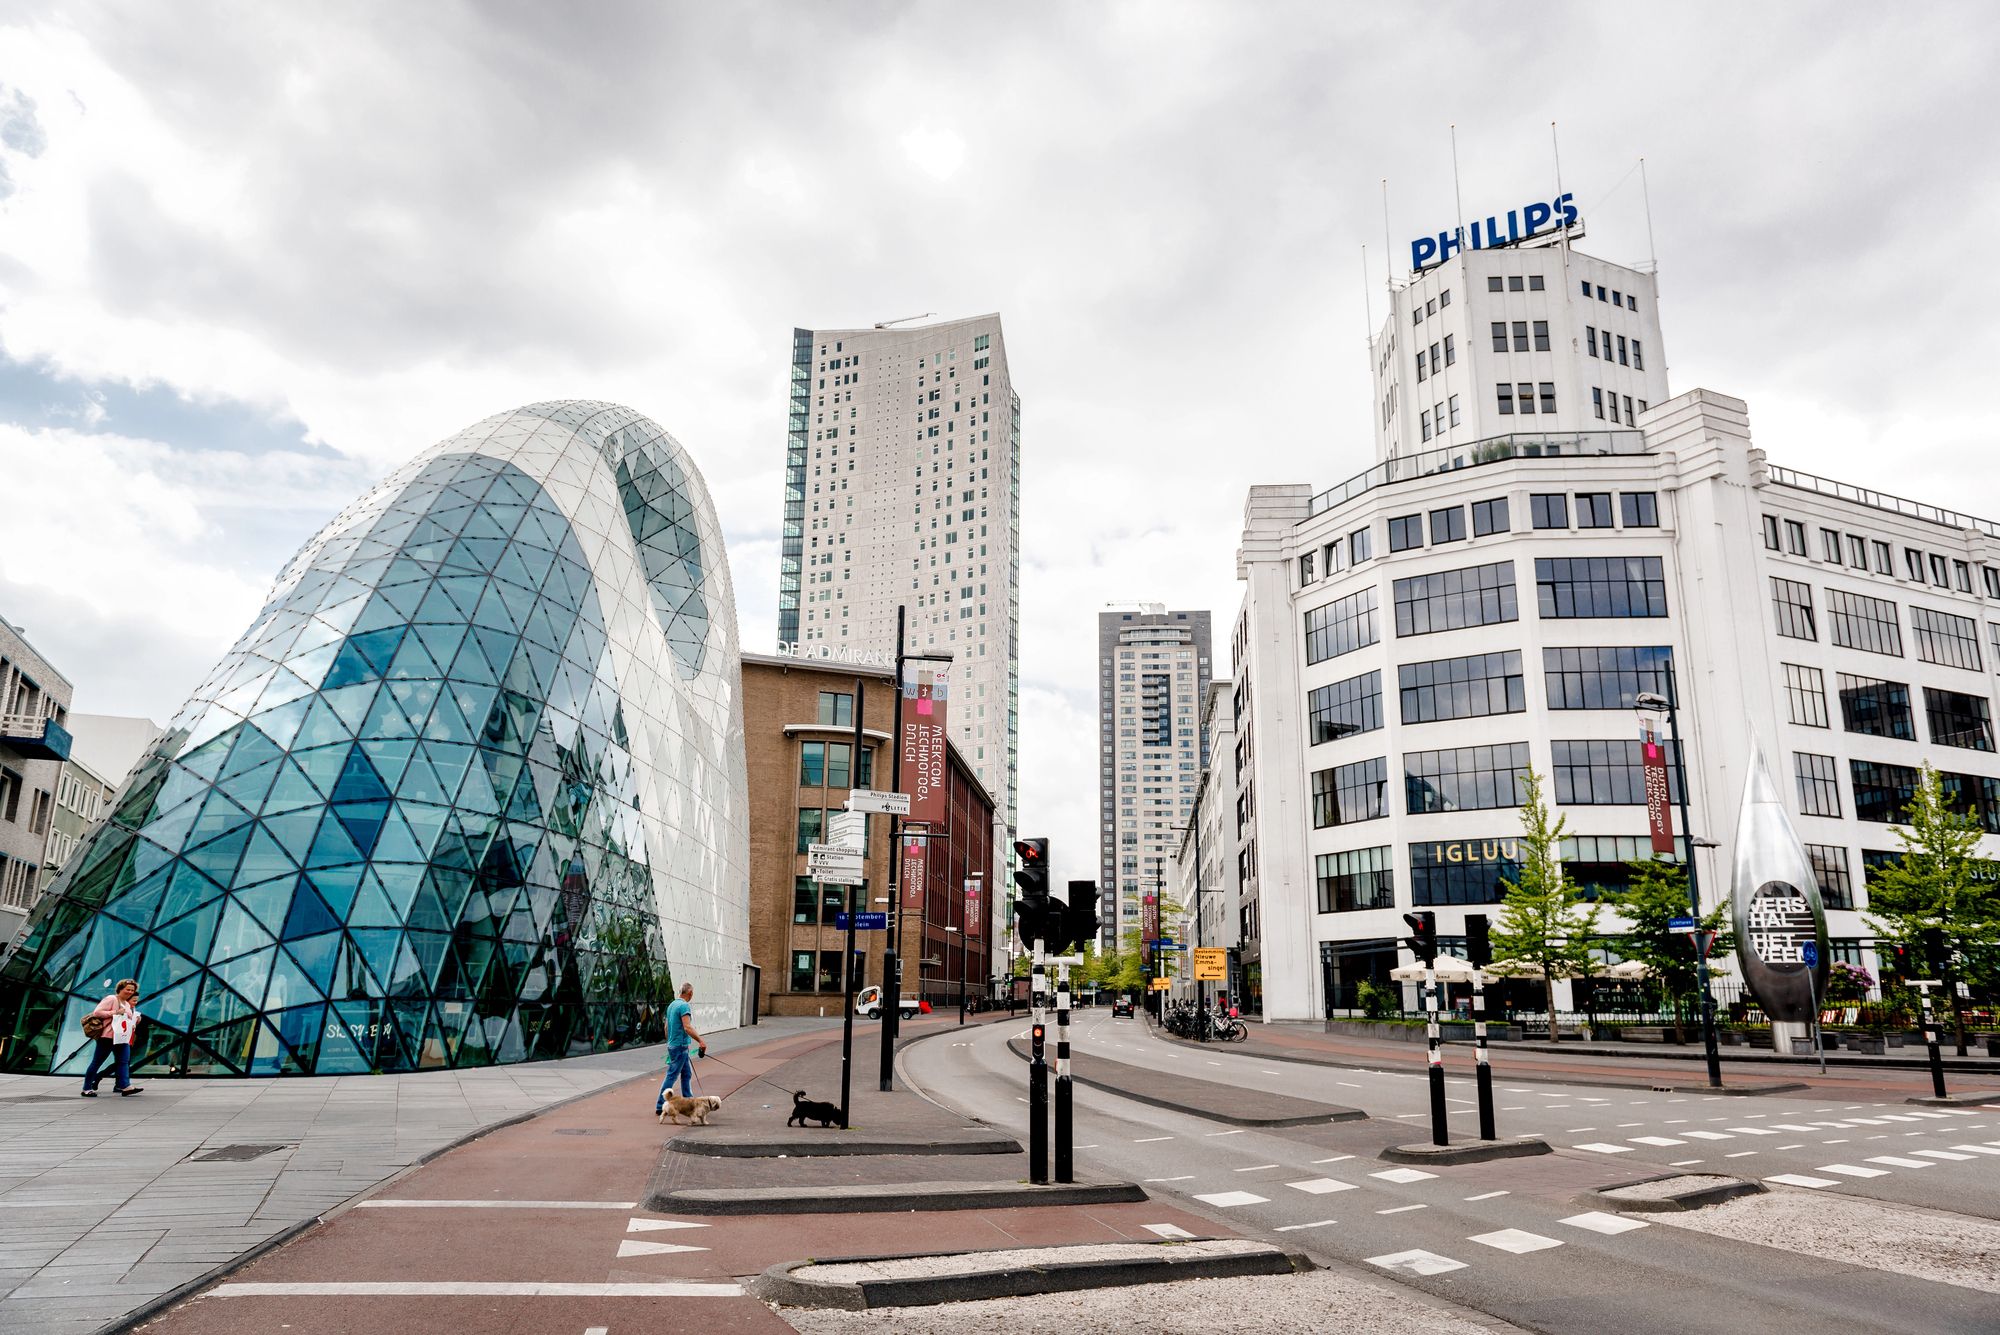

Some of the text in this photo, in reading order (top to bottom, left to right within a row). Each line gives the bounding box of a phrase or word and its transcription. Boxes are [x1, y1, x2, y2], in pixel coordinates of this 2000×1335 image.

[1411, 192, 1578, 270] PHILIPS
[777, 640, 800, 657] DE
[1644, 765, 1656, 820] WEEK.COM
[1657, 767, 1667, 801] DUTCH
[1650, 766, 1664, 835] TECHNOLOGY
[1436, 841, 1517, 863] IGLUU
[1749, 897, 1806, 912] VERS
[1750, 911, 1795, 927] HAL
[326, 1022, 392, 1041] SISY-BY
